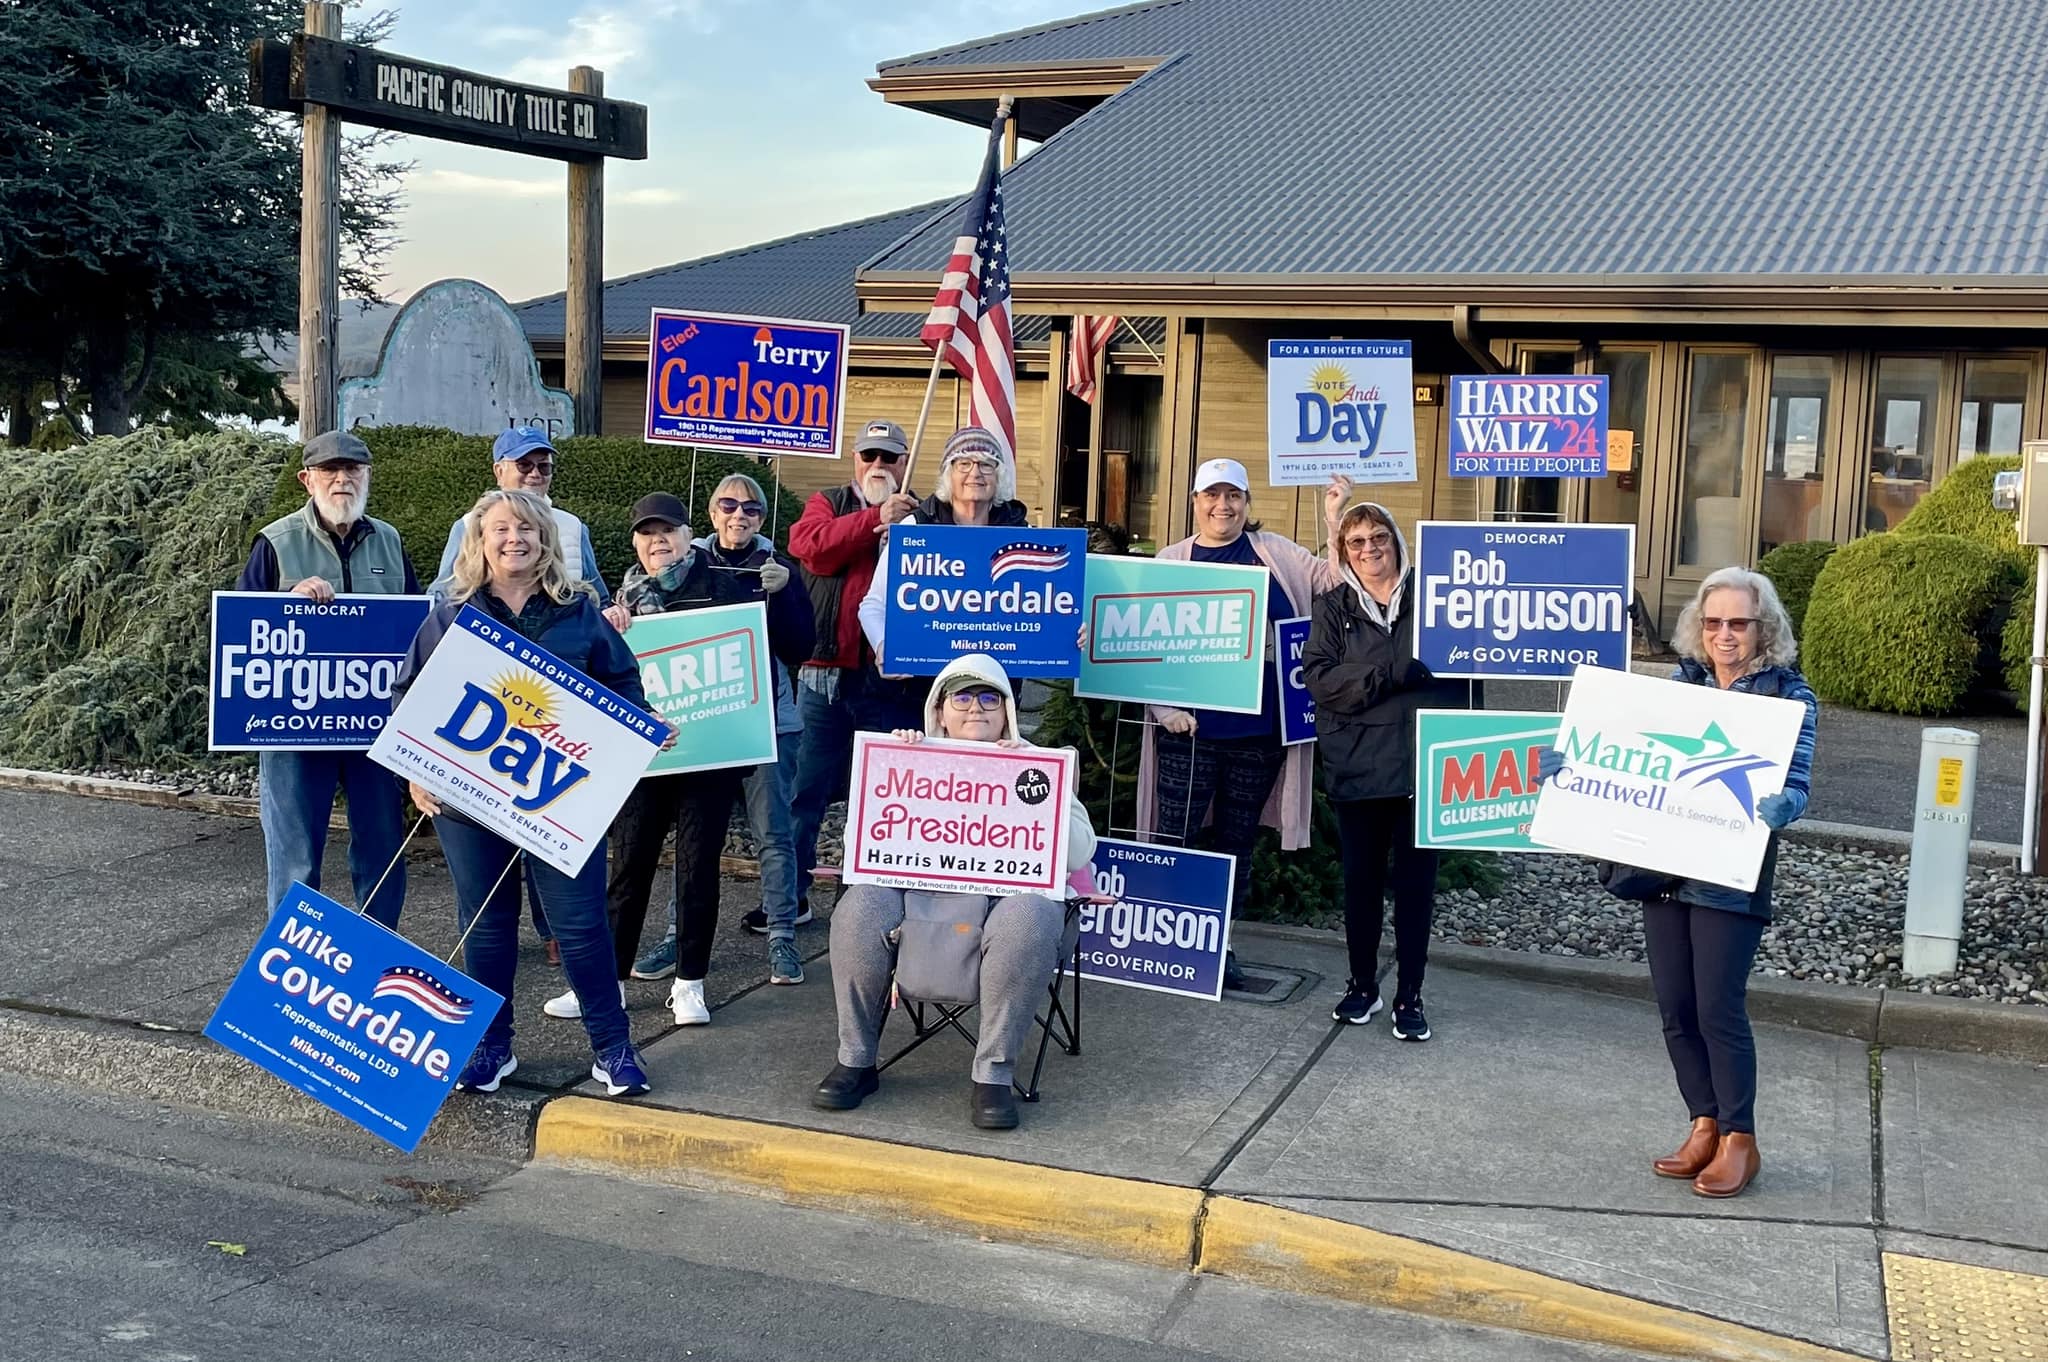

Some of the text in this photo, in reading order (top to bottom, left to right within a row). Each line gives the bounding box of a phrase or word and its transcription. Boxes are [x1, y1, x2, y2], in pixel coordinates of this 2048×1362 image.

[377, 63, 598, 140] PACIFIC COUNTY TITLE CO.
[660, 322, 700, 353] Elect
[1279, 346, 1404, 355] FOR A BRIGHTER FUTURE
[753, 338, 831, 374] Terry
[658, 357, 829, 428] Carlson
[1316, 381, 1346, 390] VOTE
[1334, 383, 1381, 402] Andi
[1416, 387, 1433, 401] CO.
[1457, 380, 1599, 416] HARRIS
[654, 428, 735, 441] ElectTerryCarlson.com
[678, 421, 695, 431] 19th
[696, 422, 708, 431] LD
[709, 423, 766, 437] Representative
[767, 430, 797, 440] Position
[798, 432, 805, 440] 2
[1296, 392, 1387, 459] Day
[1455, 417, 1549, 453] WALZ
[1321, 462, 1356, 470] DISTRICT
[1455, 457, 1601, 473] FOR THE PEOPLE
[902, 537, 926, 547] Elect
[1484, 533, 1566, 545] DEMOCRAT
[900, 553, 966, 577] Mike
[1453, 549, 1506, 586] Bob
[283, 604, 367, 617] DEMOCRAT
[896, 581, 1074, 614] Coverdale
[1425, 574, 1623, 642] Ferguson
[932, 620, 1012, 633] Representative
[1014, 620, 1041, 632] LD19
[1102, 599, 1244, 639] MARIE
[251, 619, 306, 656] Bob
[951, 639, 1017, 652] Mike19.com
[1100, 637, 1241, 653] GLUESENKAMP PEREZ
[641, 641, 744, 699] ARIE
[1166, 653, 1240, 664] FOR CONGRESS
[1448, 646, 1599, 665] for GOVERNOR
[221, 644, 404, 711] Ferguso
[470, 619, 502, 643] FOR
[504, 641, 517, 652] A
[520, 648, 595, 700] BRIGHTER
[598, 696, 656, 737] FUTURE
[702, 682, 745, 703] PEREZ
[501, 687, 545, 720] VOTE
[691, 699, 747, 722] CONGRESS
[245, 714, 391, 733] for GOVERNO
[518, 717, 593, 762] Andi
[434, 681, 591, 812] Day
[1563, 726, 1673, 782] Maria
[874, 767, 1008, 806] Madam
[1028, 770, 1039, 781] &
[395, 744, 568, 851] 19TH LEG. DISTRICT SENATE D
[1552, 766, 1667, 811] Cantwell
[1687, 808, 1728, 827] Senator
[1729, 818, 1746, 833] (D)
[870, 803, 1046, 851] President
[867, 848, 1043, 877] Harris Walz 2024
[1108, 849, 1177, 867] DEMOCRAT
[876, 877, 893, 885] Paid
[894, 878, 905, 886] for
[906, 879, 916, 888] by
[917, 880, 958, 890] Democrats
[959, 883, 967, 891] of
[968, 884, 993, 894] Pacific
[297, 900, 325, 922] Elect
[1079, 902, 1220, 953] erguson
[278, 915, 354, 975] Mike
[1091, 951, 1196, 981] GOVERNOR
[258, 947, 451, 1080] Coverdale
[281, 1003, 400, 1078] Representative LD19
[290, 1035, 361, 1084] Mike19.com
